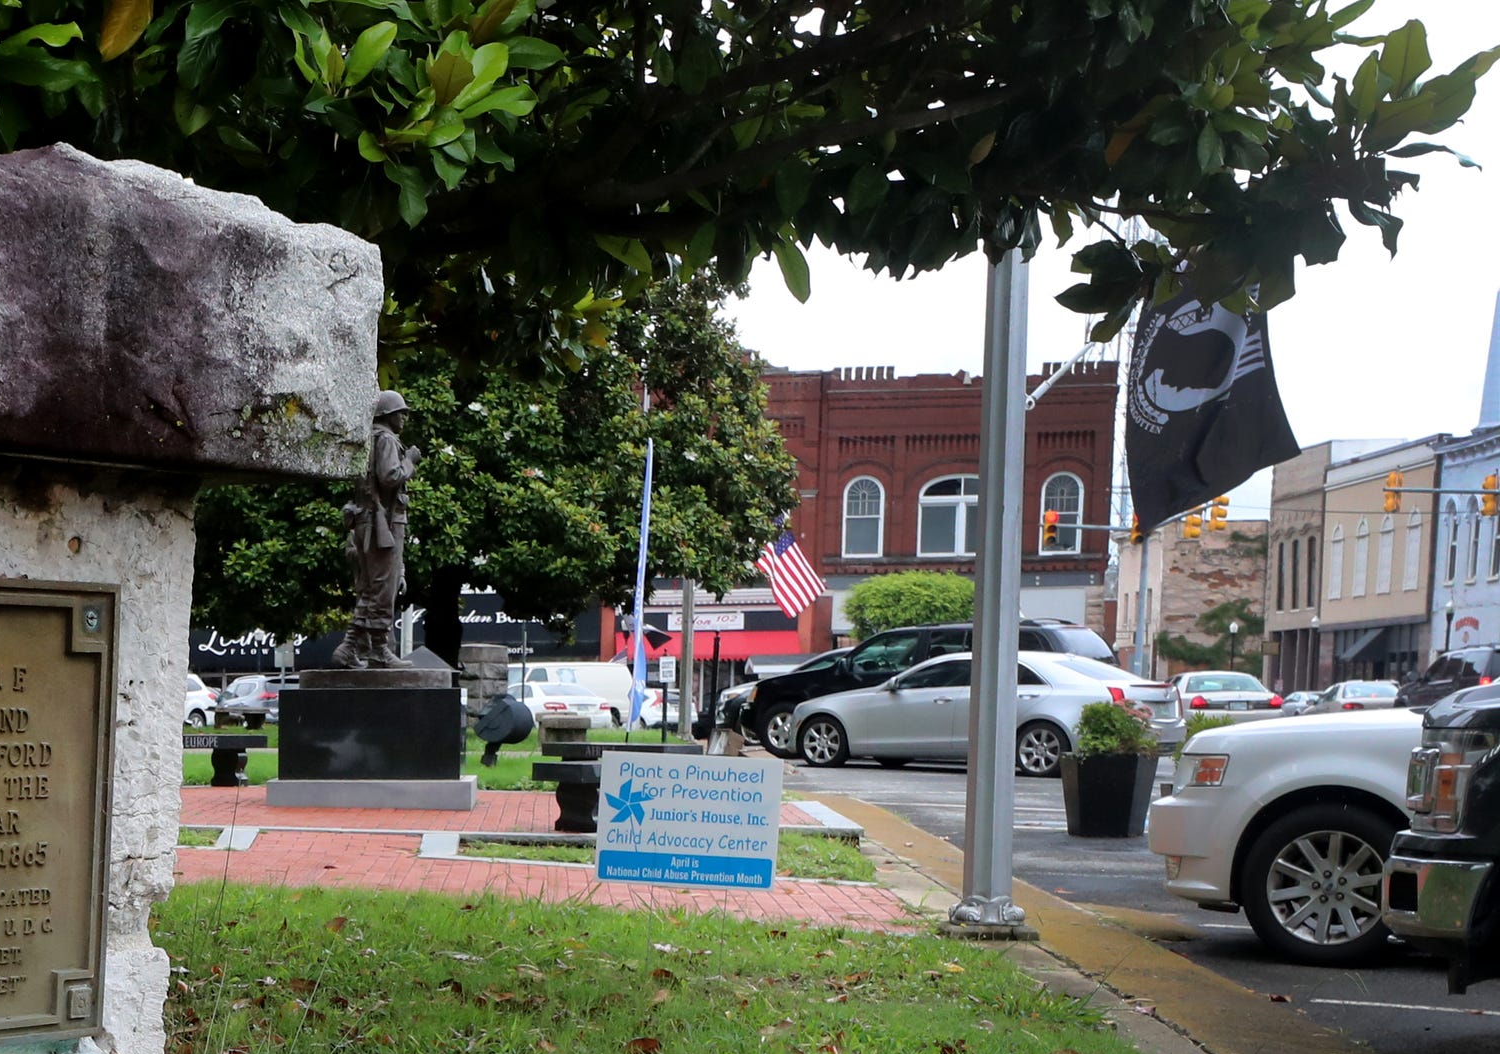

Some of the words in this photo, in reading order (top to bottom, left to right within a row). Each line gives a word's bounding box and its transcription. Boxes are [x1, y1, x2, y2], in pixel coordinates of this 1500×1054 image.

[674, 615, 712, 626] Slon
[716, 614, 738, 624] 102
[229, 648, 301, 656] FLOWS
[184, 736, 219, 748] EUROPE
[619, 761, 663, 779] Plant
[668, 768, 680, 779] a
[685, 764, 765, 784] Pinwheel
[3, 775, 49, 801] THE
[641, 782, 666, 798] for
[671, 783, 763, 803] Prevention
[649, 808, 698, 822] Junior's
[747, 813, 769, 826] Inc.
[606, 828, 643, 845] Child
[647, 831, 714, 853] Advocacy
[718, 834, 768, 851] Center
[670, 856, 690, 869] April
[691, 858, 699, 868] is
[606, 865, 640, 877] National
[642, 867, 662, 879] Child
[664, 868, 689, 880] Abuse
[691, 869, 735, 883] Prevention
[736, 873, 763, 885] Month
